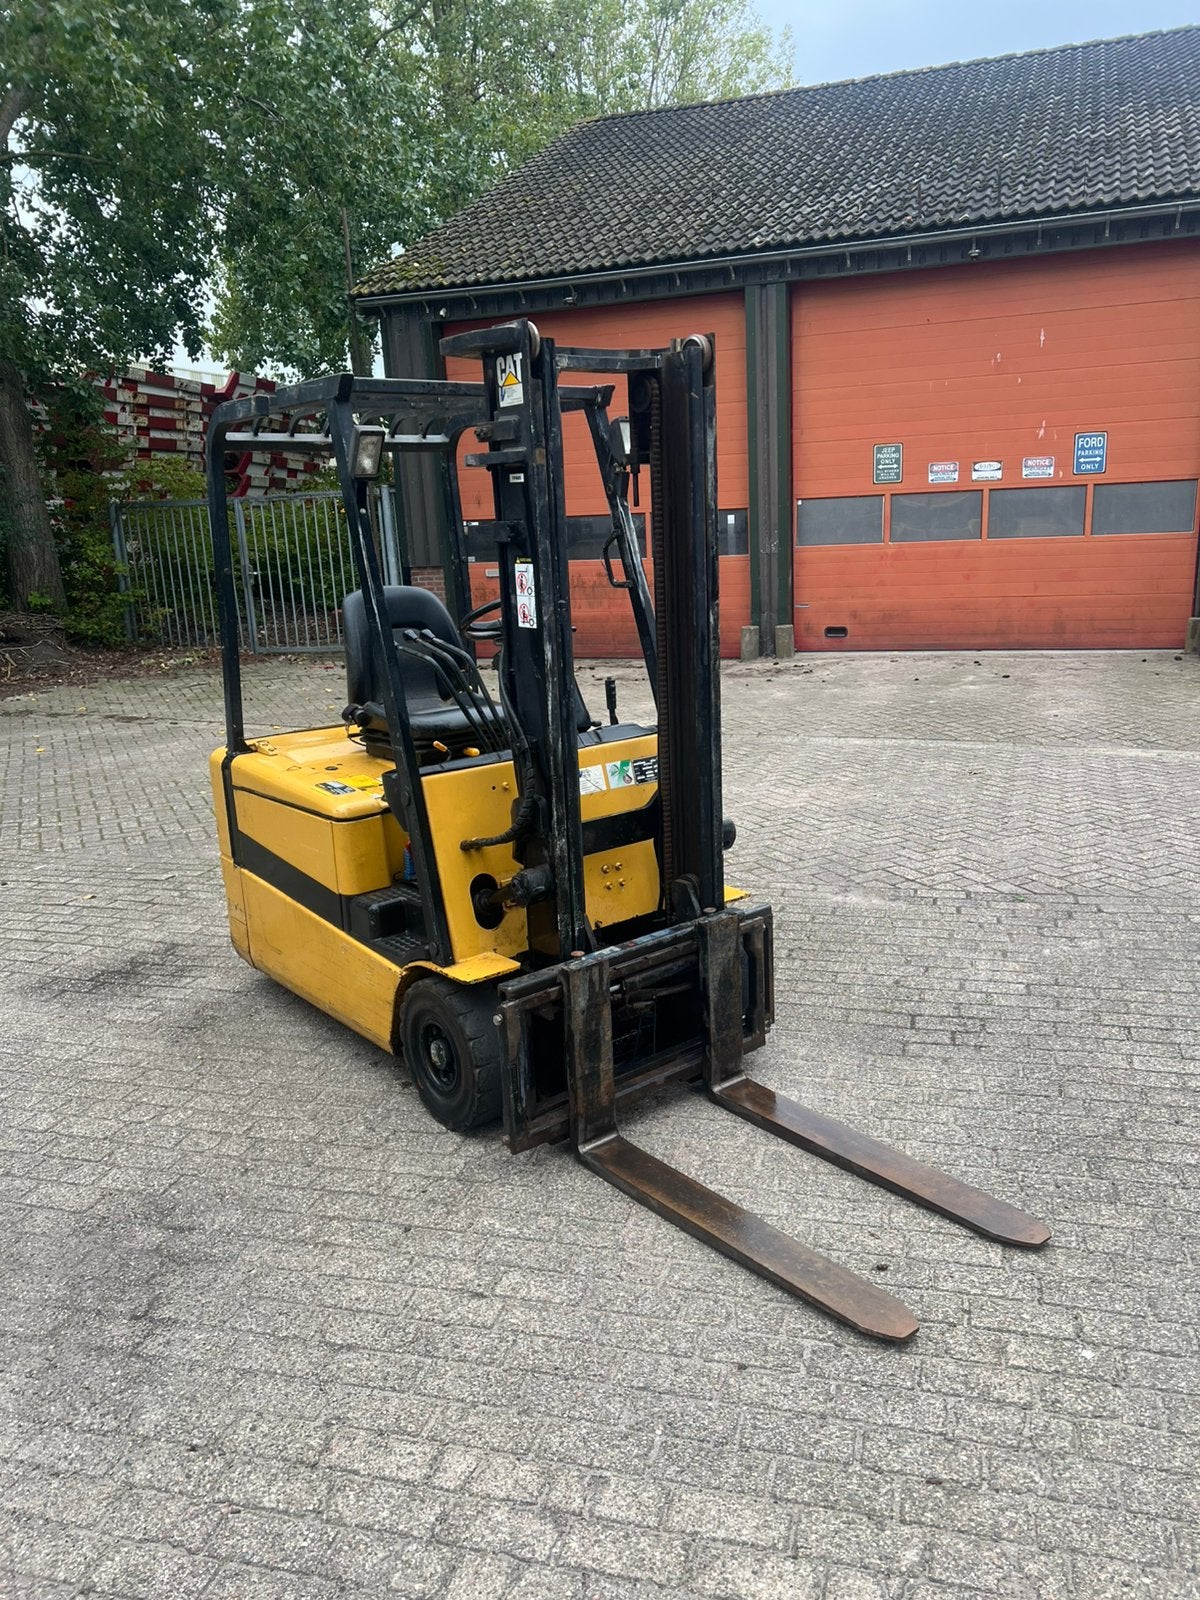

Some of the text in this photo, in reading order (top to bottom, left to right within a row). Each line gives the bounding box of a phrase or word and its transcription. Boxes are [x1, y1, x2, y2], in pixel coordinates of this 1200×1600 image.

[496, 352, 523, 386] CAT
[1078, 436, 1104, 448] FORD
[881, 446, 896, 454] JEEP
[1077, 448, 1104, 456] PARKING
[1027, 459, 1050, 467] NOTICE
[933, 464, 955, 472] NOTICE
